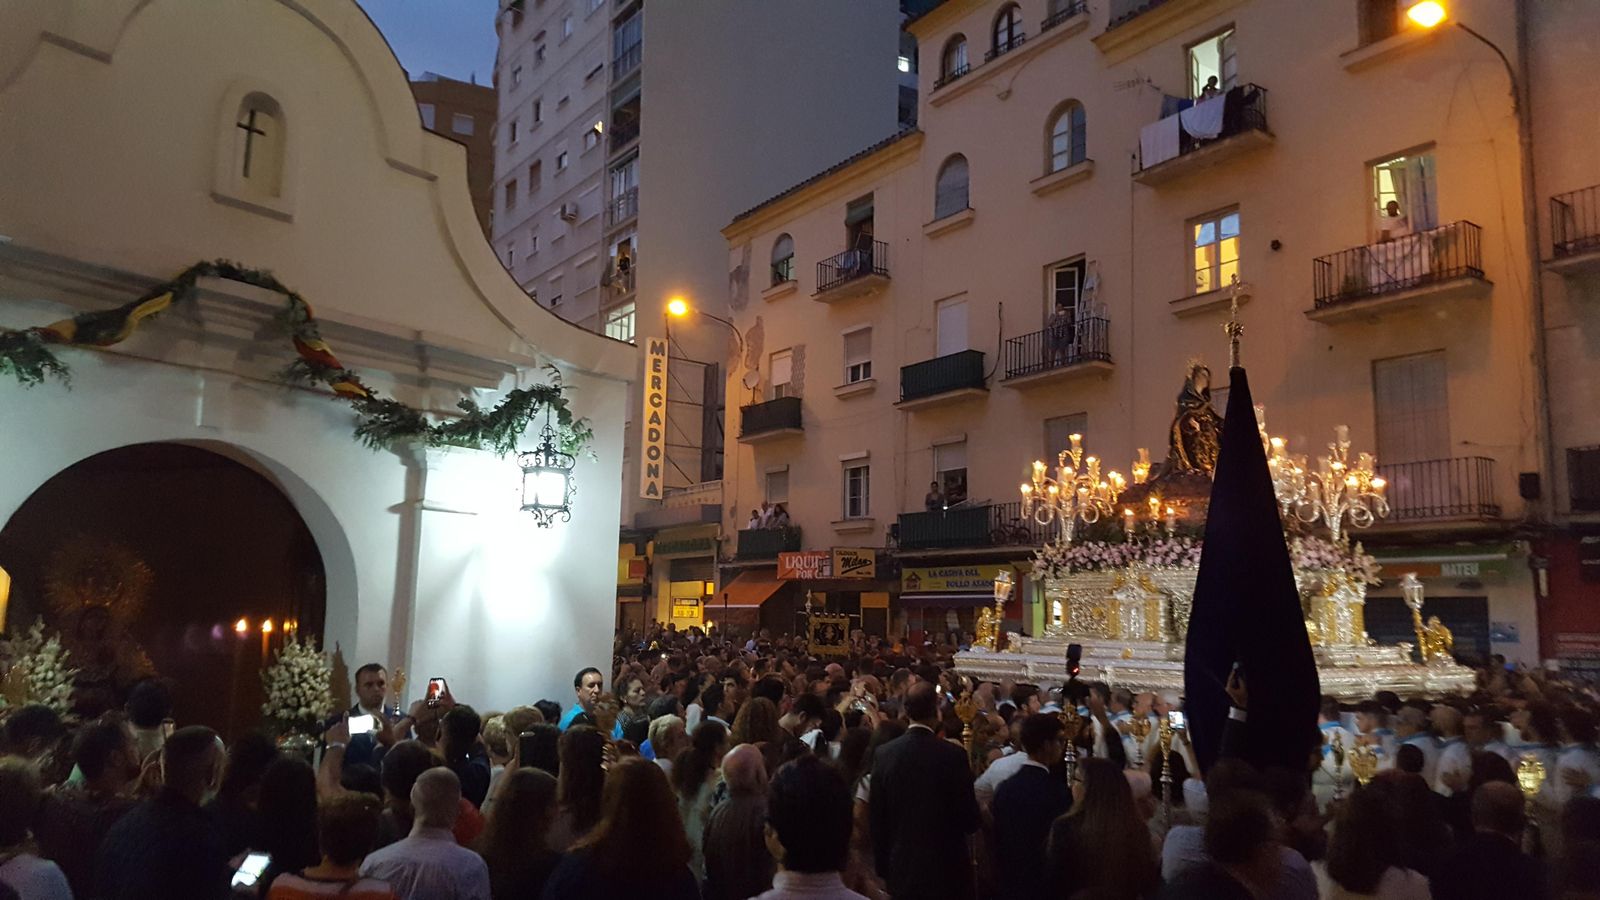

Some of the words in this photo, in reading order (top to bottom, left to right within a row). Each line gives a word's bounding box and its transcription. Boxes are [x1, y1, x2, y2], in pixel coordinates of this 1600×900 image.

[645, 340, 666, 496] MERCADONA
[928, 570, 939, 578] LA
[965, 568, 979, 577] DEL
[946, 580, 970, 588] POLLO
